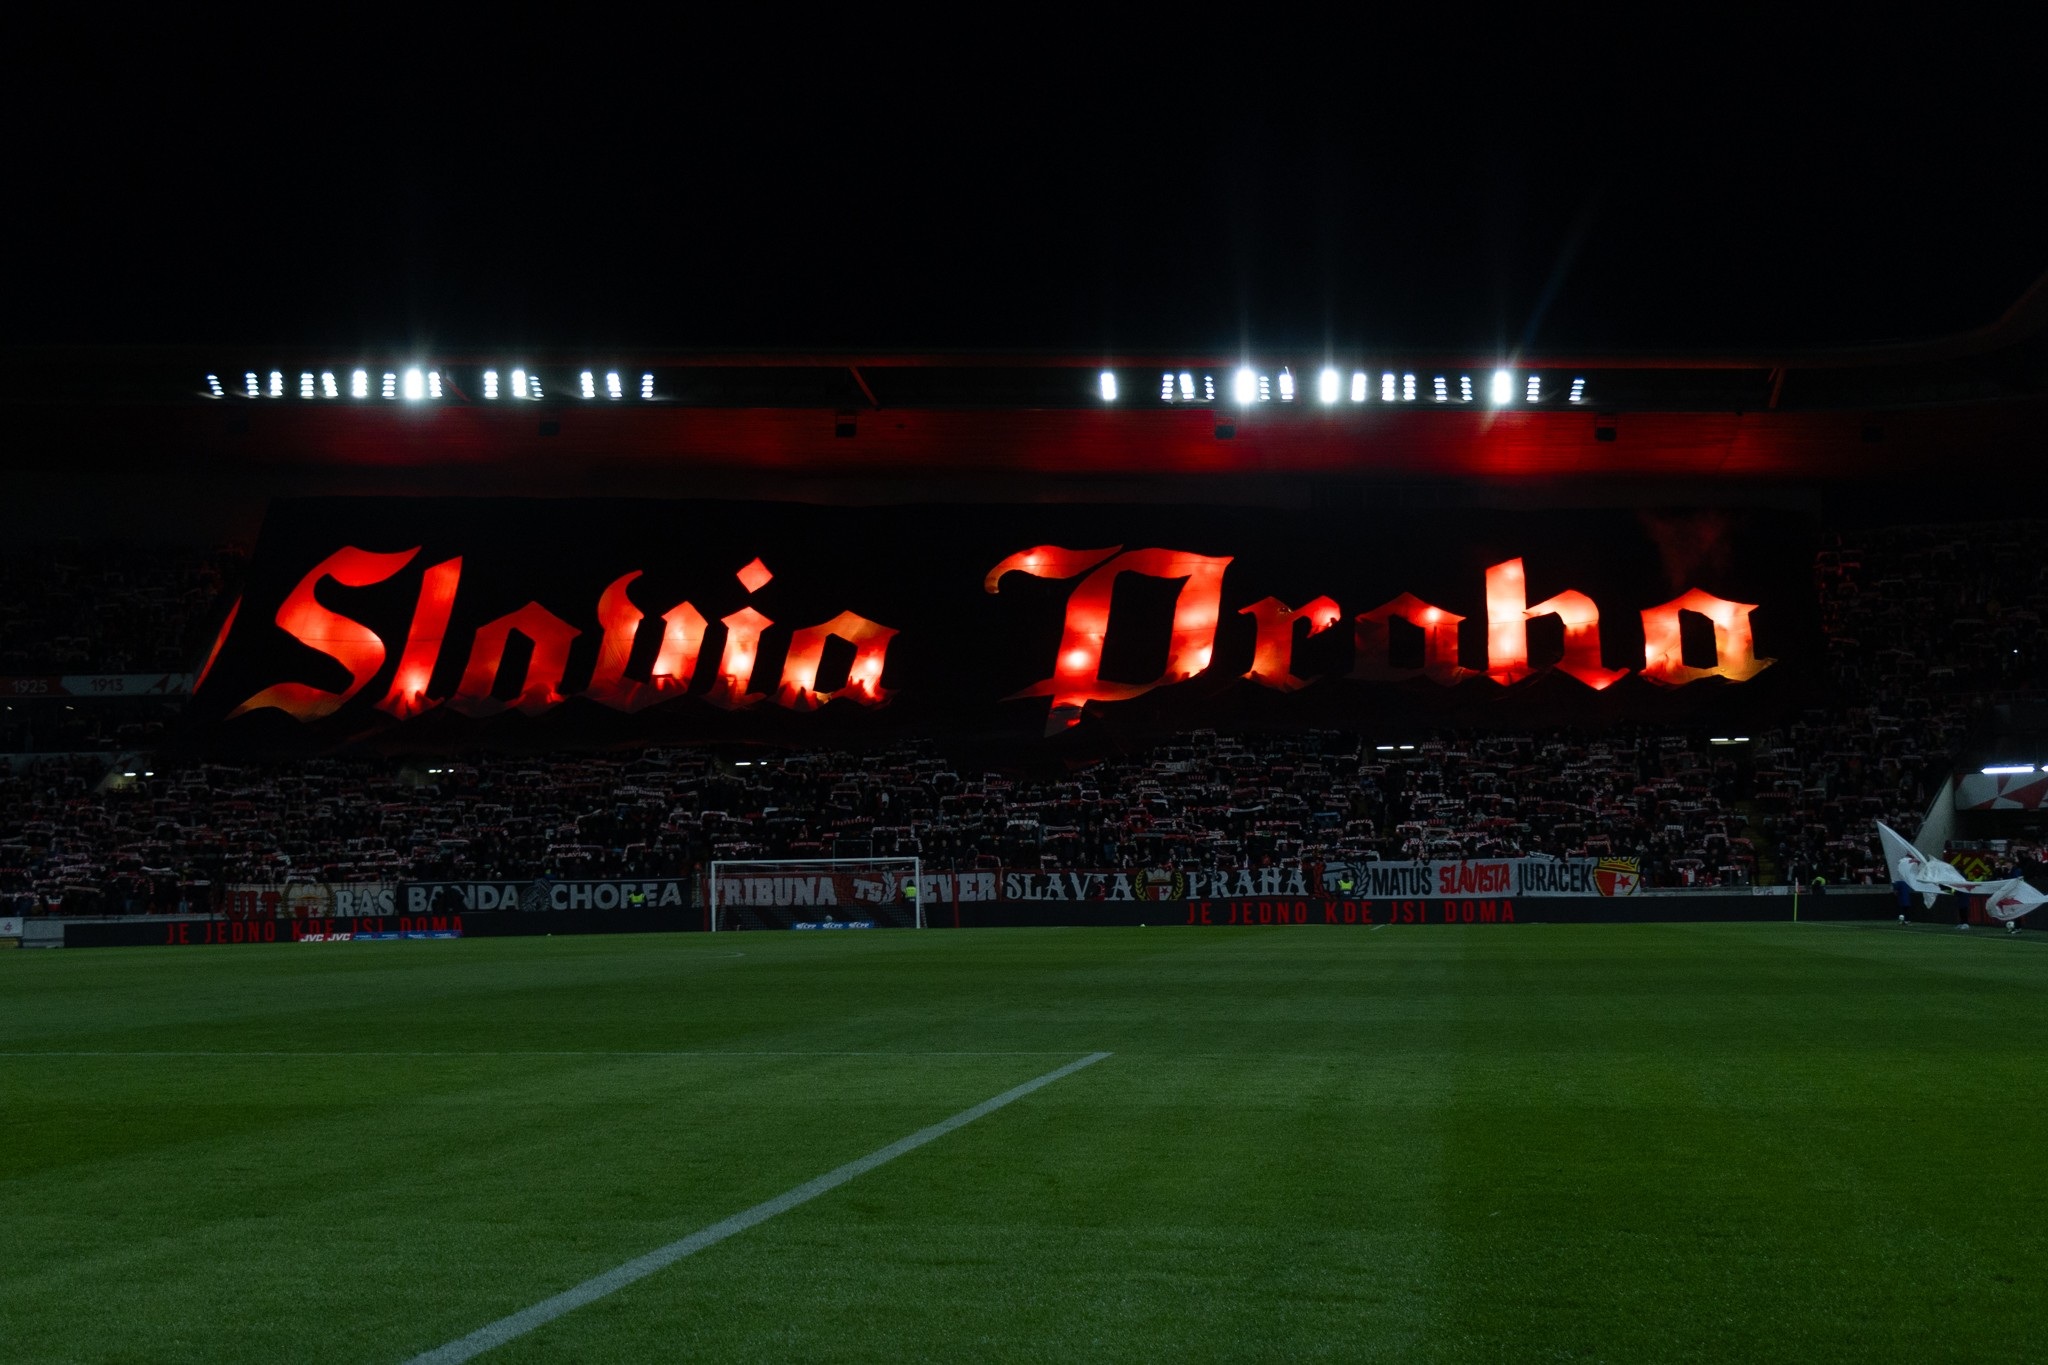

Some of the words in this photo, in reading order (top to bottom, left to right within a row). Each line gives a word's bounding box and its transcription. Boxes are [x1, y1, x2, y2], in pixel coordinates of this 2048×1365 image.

[226, 544, 901, 722] Slavia
[983, 544, 1779, 737] Praha
[12, 680, 48, 694] 1925
[91, 679, 123, 691] 1913
[708, 877, 838, 906] TRIBUNA
[1185, 867, 1310, 900] PRAHA
[226, 890, 282, 920] ULT
[335, 888, 395, 917] RAS
[1187, 901, 1213, 925] JE
[1228, 901, 1308, 925] JEDNO
[1325, 900, 1373, 924] KDE
[1390, 900, 1426, 924] JSI
[1445, 899, 1515, 923] DOMA
[166, 922, 190, 944] JE
[205, 920, 276, 944] JEDNO
[400, 915, 464, 932] DOMA
[300, 934, 325, 942] JVC
[327, 933, 352, 941] JVC
